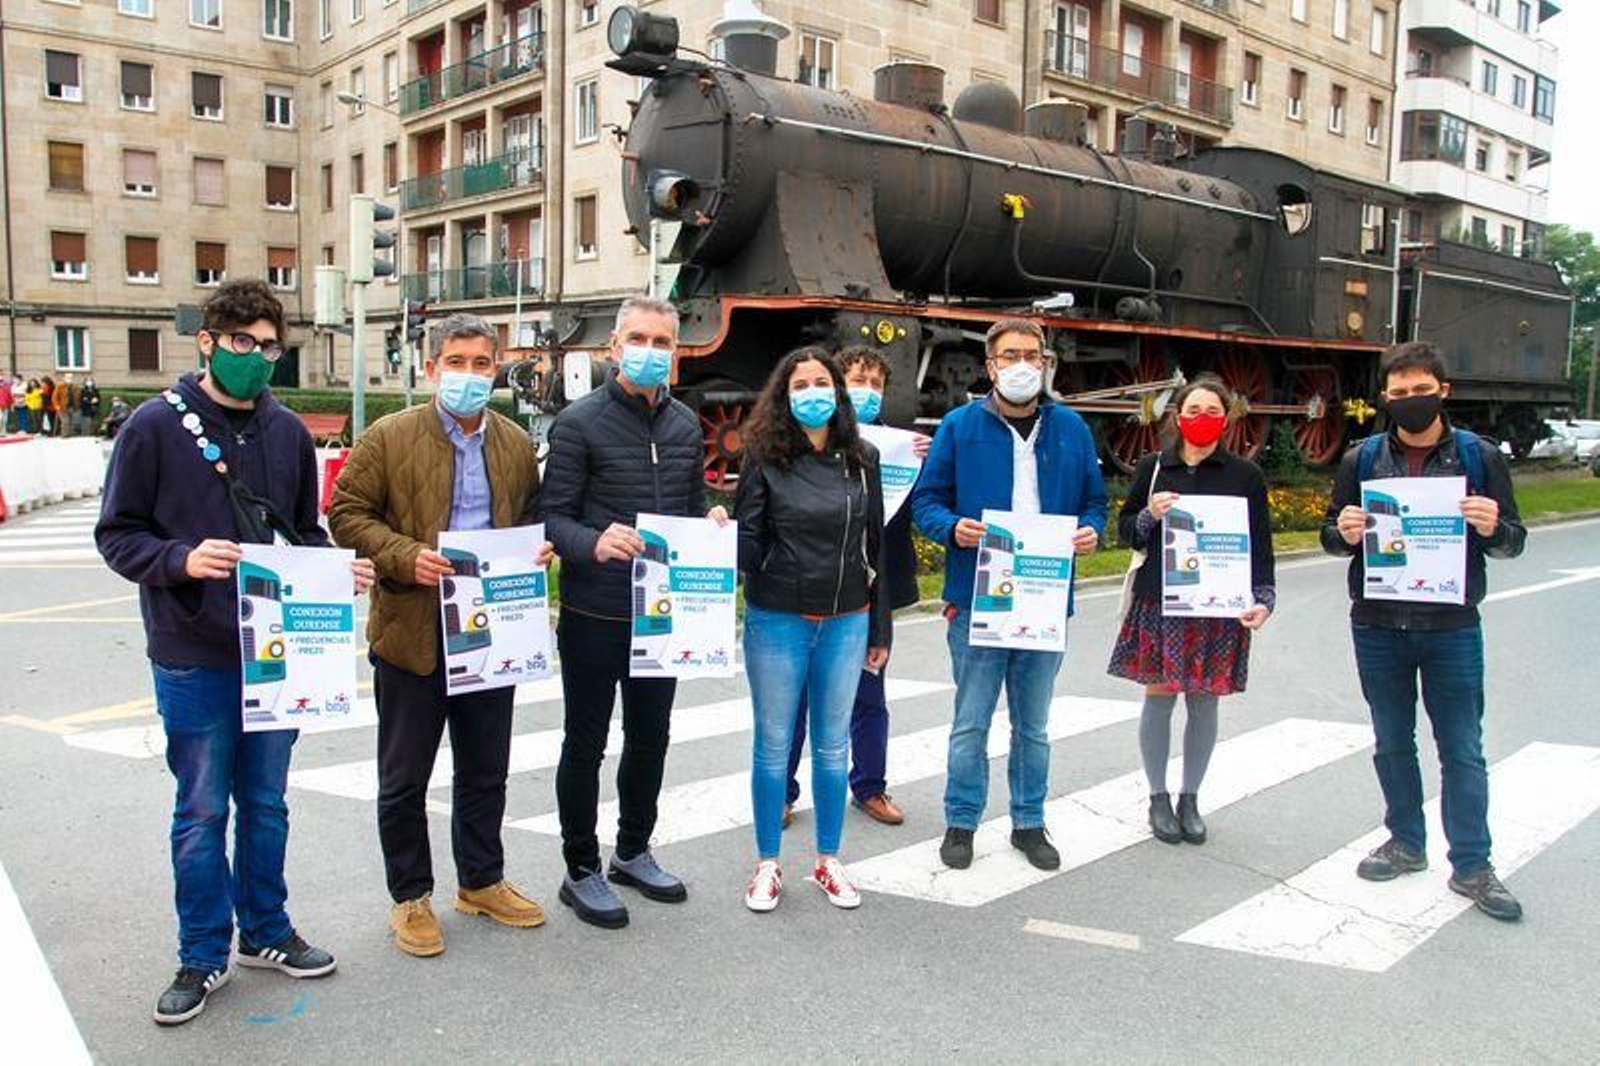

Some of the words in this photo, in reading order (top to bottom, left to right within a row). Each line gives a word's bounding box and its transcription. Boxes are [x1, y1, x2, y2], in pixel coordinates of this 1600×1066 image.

[1407, 517, 1456, 527] CONEXIÓN
[1411, 527, 1454, 535] OURENSE
[675, 570, 724, 580] CONEXIÓN
[489, 575, 536, 590] CONEXIÓN
[679, 581, 722, 590] OURENSE
[493, 588, 536, 600] OURENSE
[289, 607, 342, 617] CONEXIÓN
[293, 620, 341, 630] OURENSE
[295, 636, 351, 644] FRECUENCIAS
